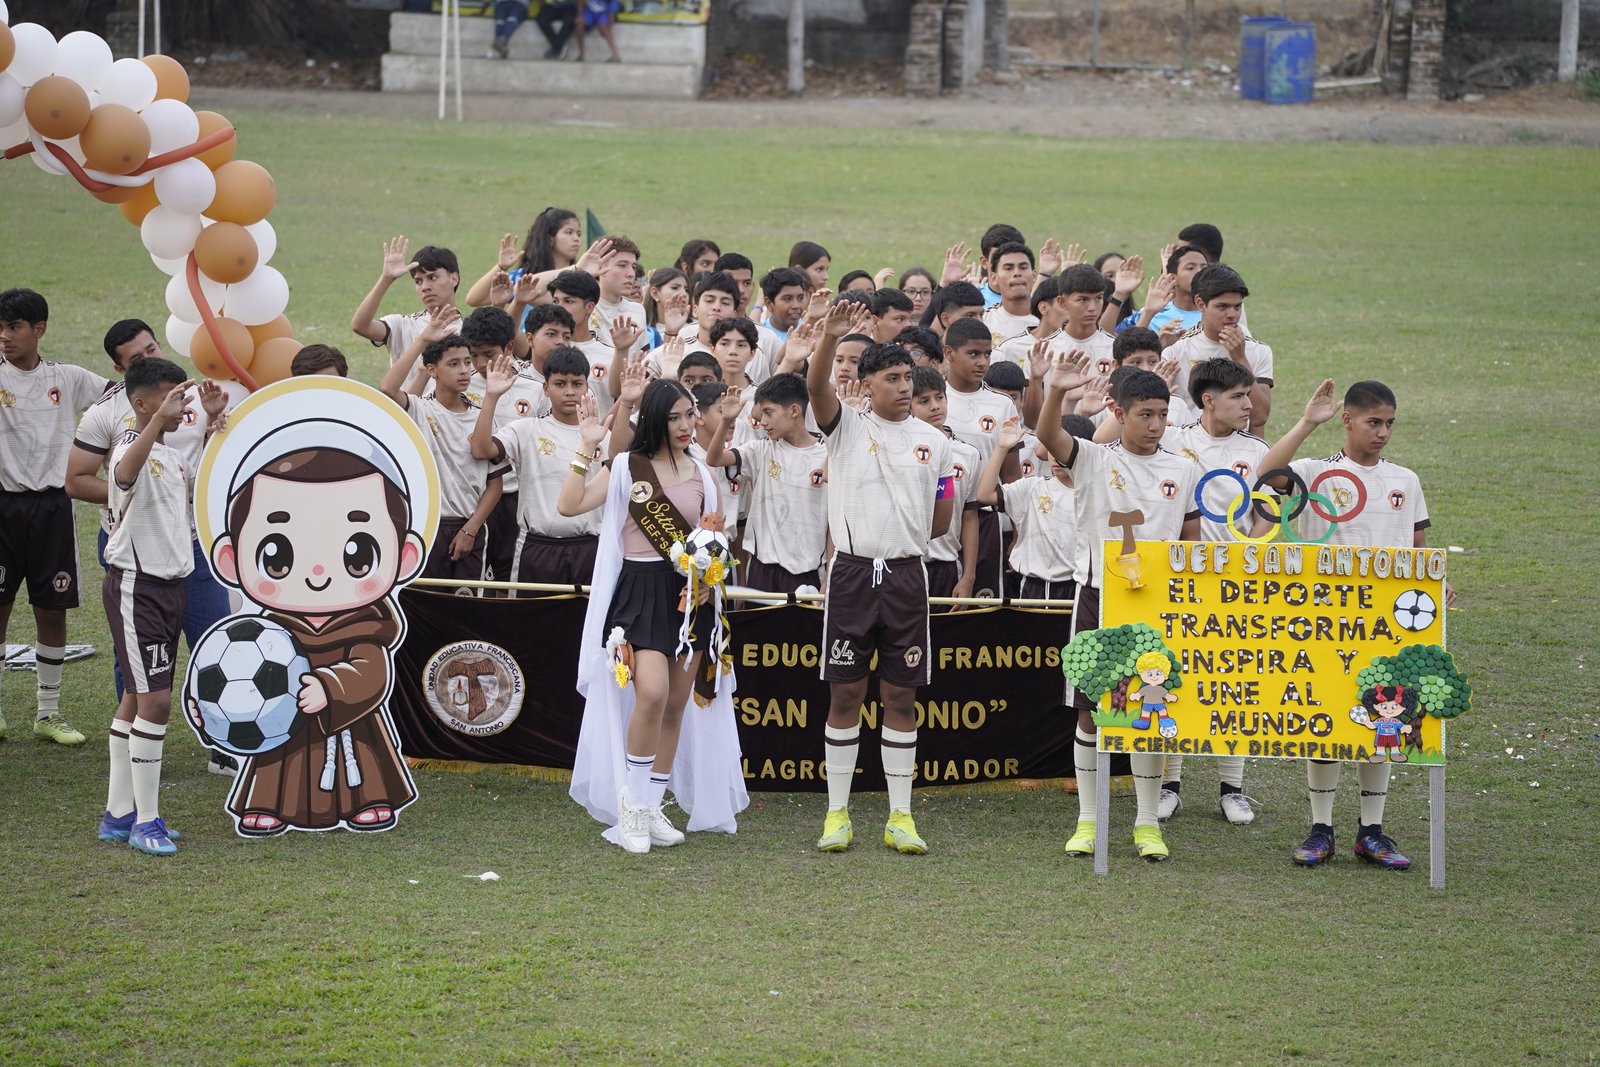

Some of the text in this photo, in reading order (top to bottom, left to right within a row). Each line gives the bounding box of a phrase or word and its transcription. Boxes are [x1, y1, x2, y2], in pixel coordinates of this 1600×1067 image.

[1242, 544, 1303, 575] SAN
[1316, 546, 1446, 581] ANTONIO
[1168, 577, 1373, 609] EL DEPORTE
[1159, 612, 1403, 645] TRANSFORMA,
[830, 638, 855, 661] 64
[939, 645, 1061, 670] FRANCIS
[1181, 648, 1360, 675] INSPIRA Y
[427, 642, 521, 694] UNIDAD EDUCATIVA FRANCISCANA
[1196, 680, 1322, 707] UNE AL
[450, 718, 505, 735] SAN ANTONIO
[1209, 710, 1334, 738] MUNDO
[1132, 736, 1214, 755] CIENCIA
[1225, 739, 1239, 756] Y
[1248, 739, 1371, 761] DISCIPLINA
